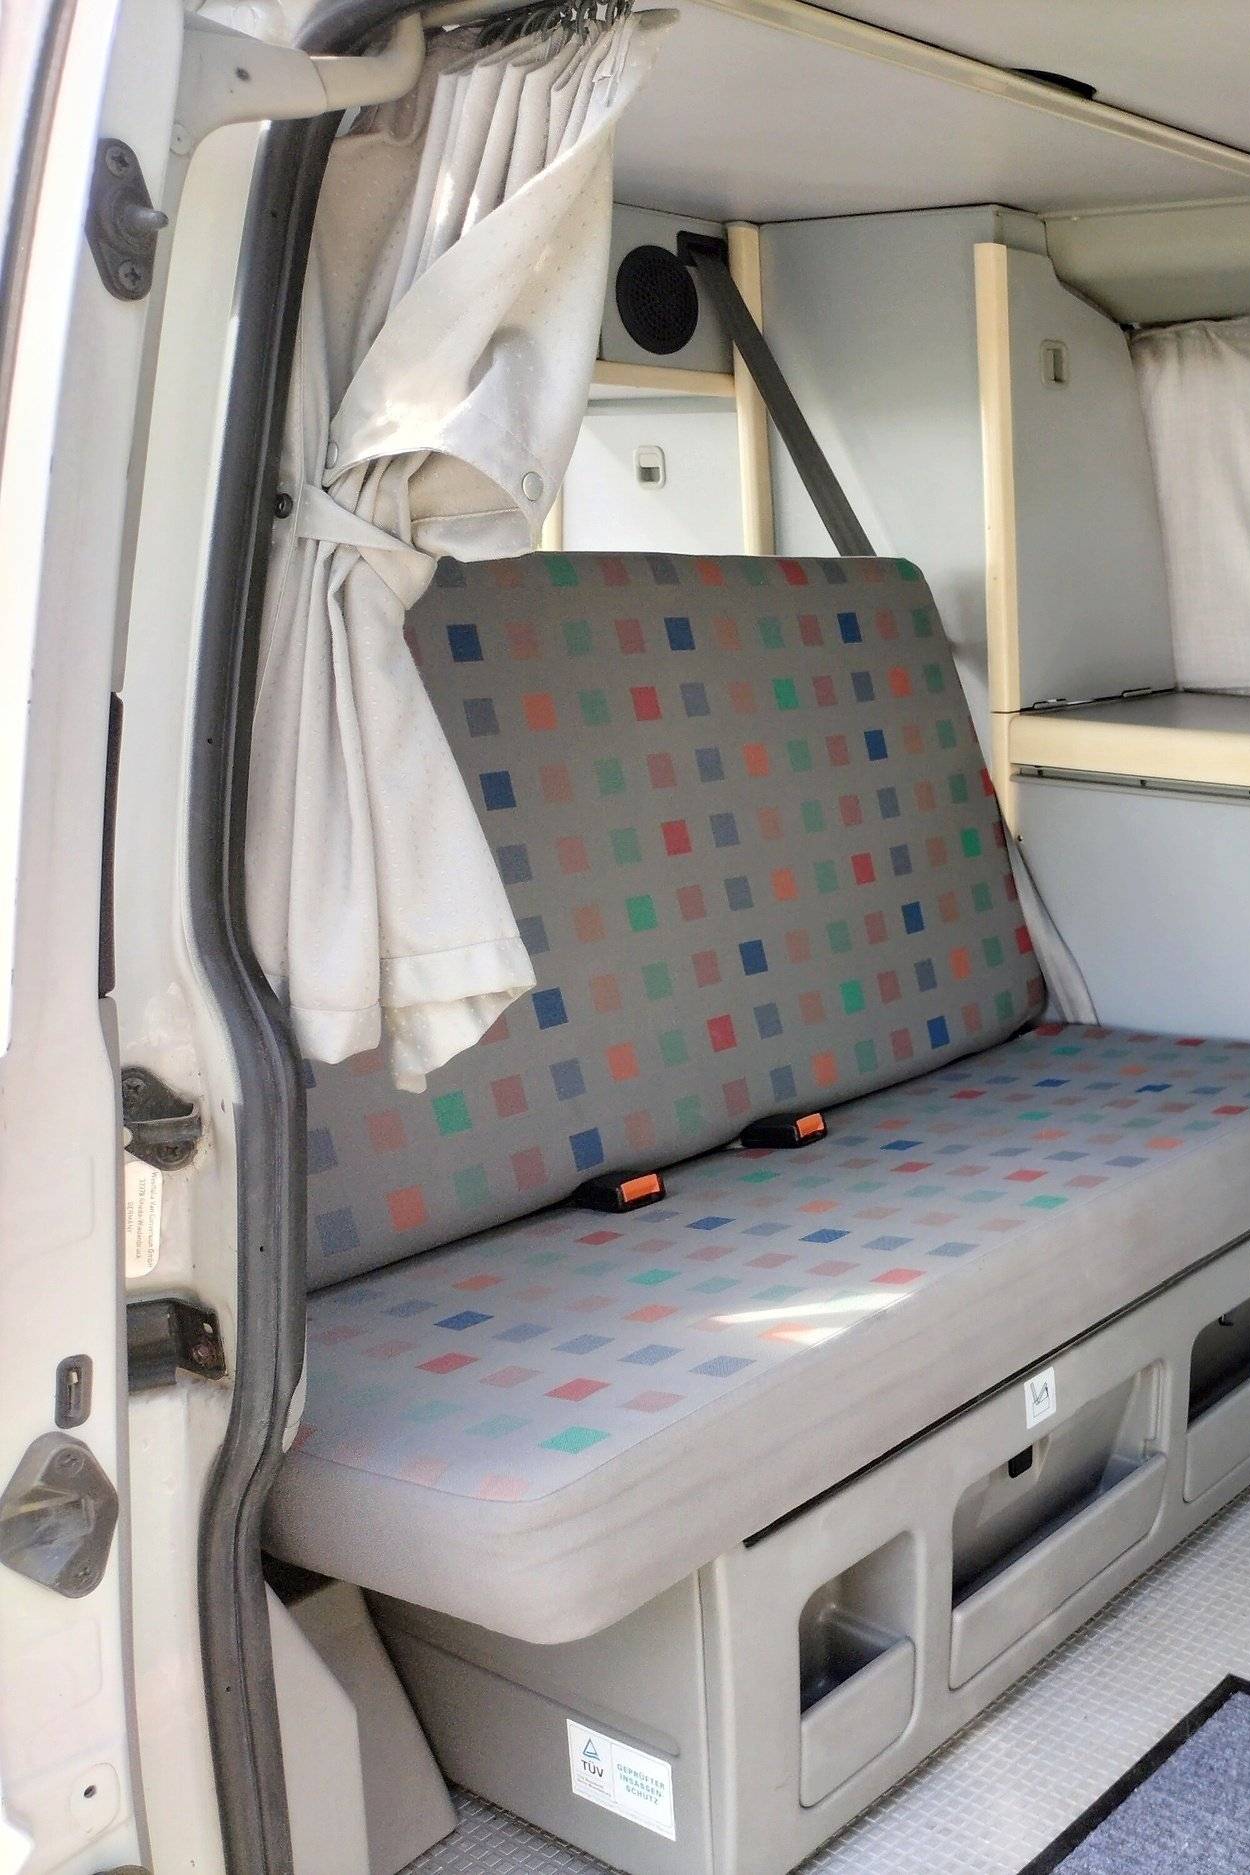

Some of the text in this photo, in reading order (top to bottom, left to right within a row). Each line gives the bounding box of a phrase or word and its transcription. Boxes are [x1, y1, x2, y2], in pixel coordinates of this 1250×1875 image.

[581, 1759, 604, 1778] TÜV
[616, 1763, 665, 1789] GEPRÜFTER
[625, 1786, 659, 1805] SCHUTZ
